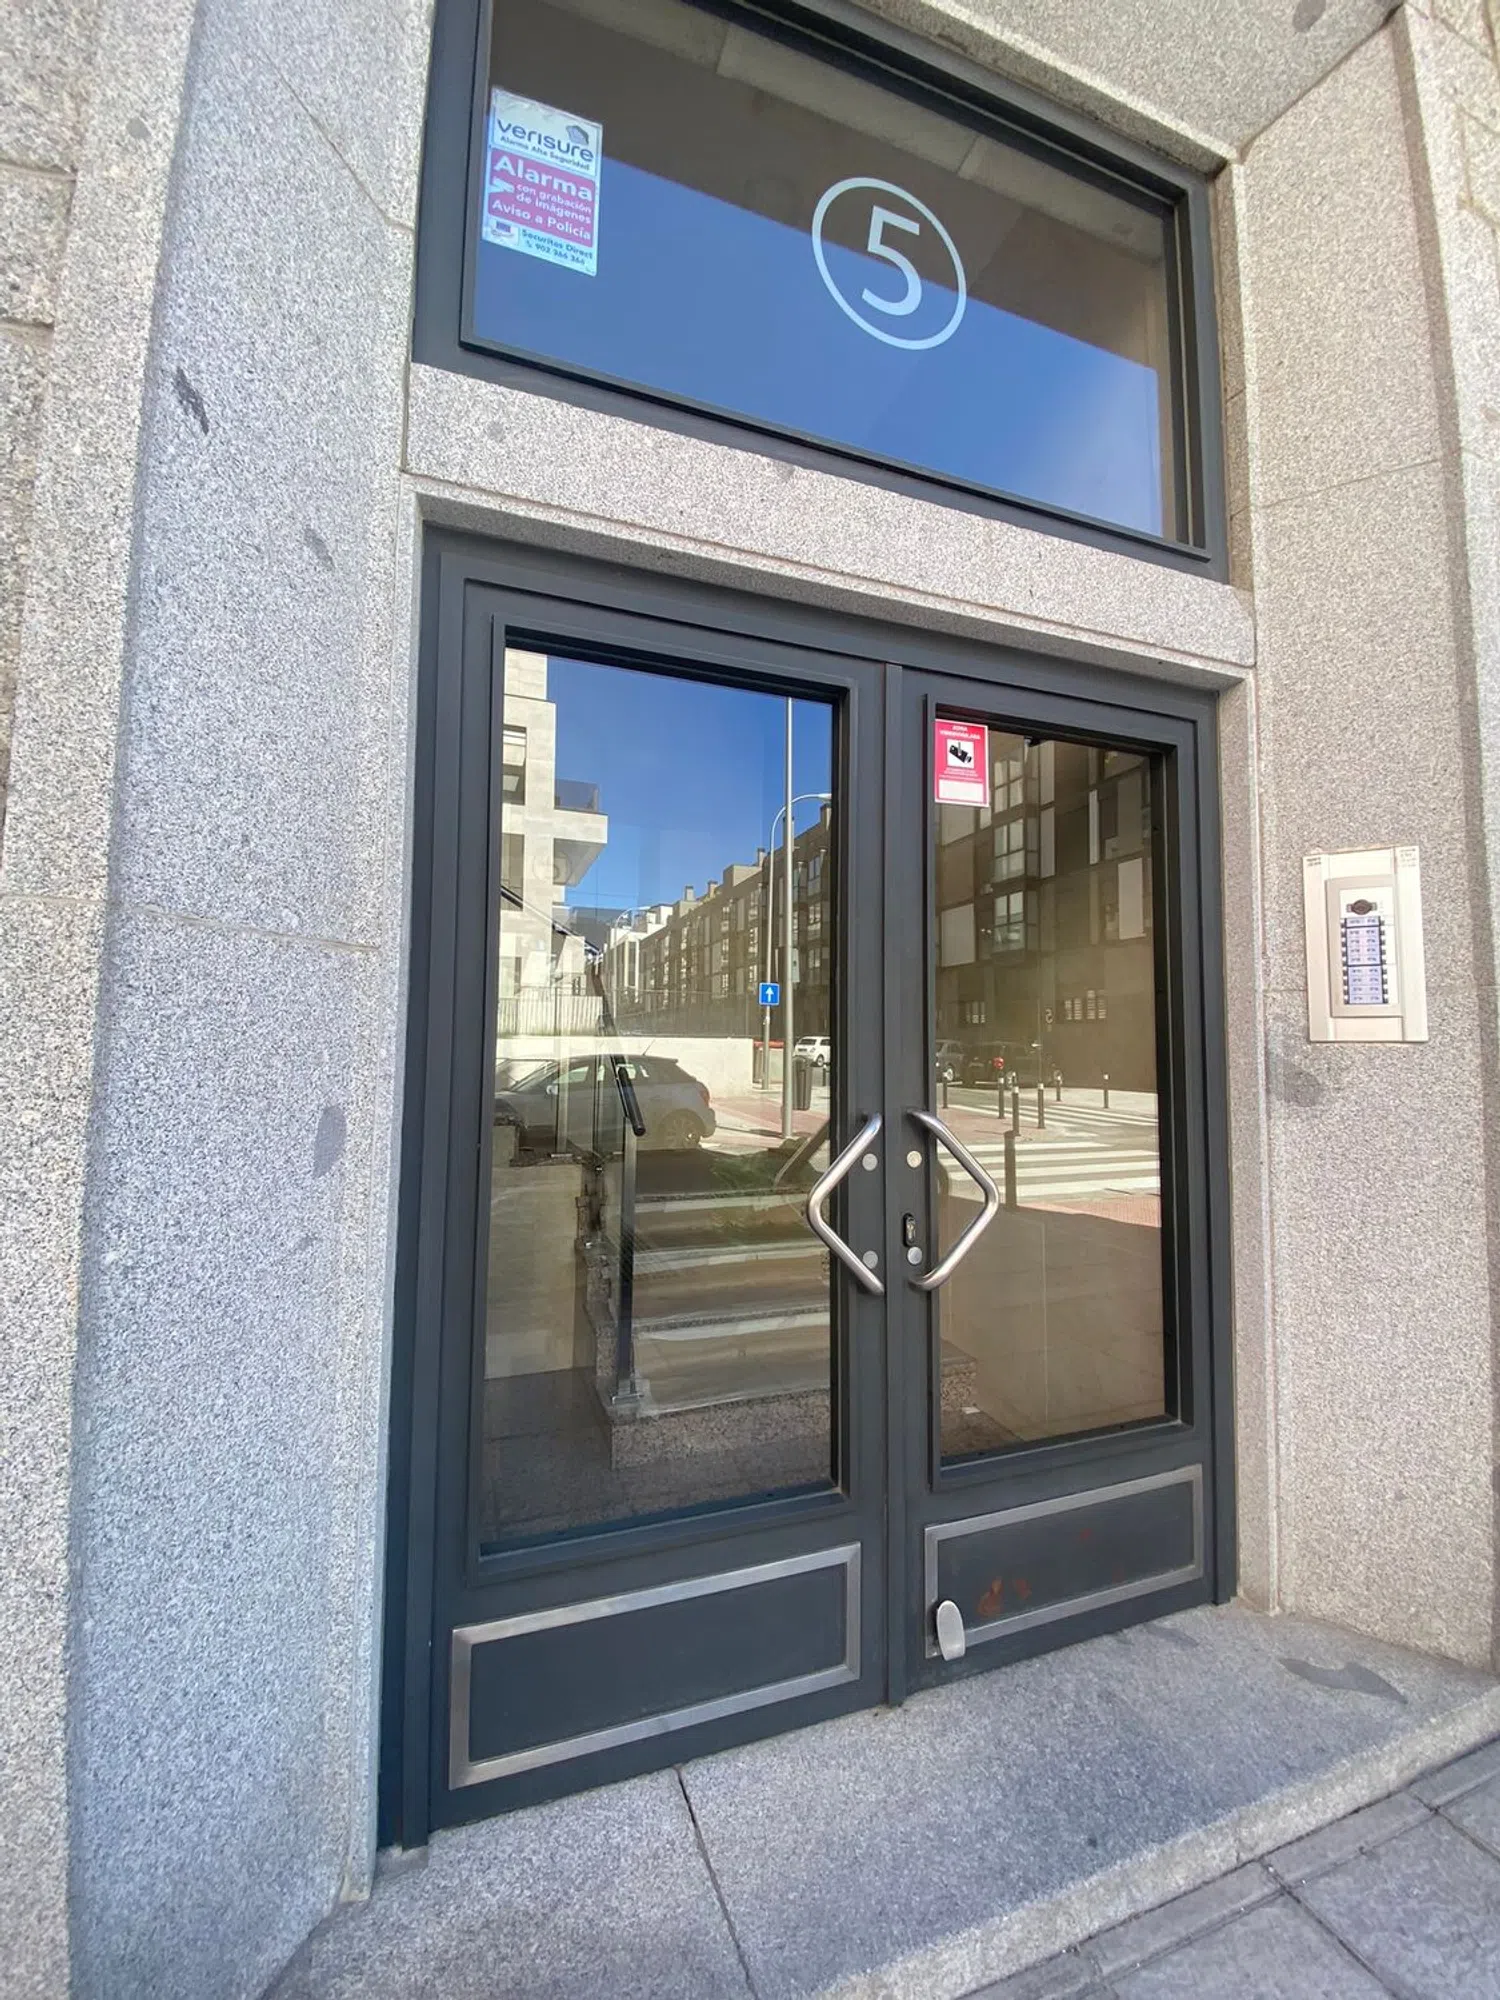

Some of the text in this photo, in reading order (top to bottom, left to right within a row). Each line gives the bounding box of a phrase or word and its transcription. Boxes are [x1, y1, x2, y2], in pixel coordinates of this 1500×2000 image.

[497, 119, 594, 162] verisure
[493, 155, 592, 202] Alarma
[549, 151, 590, 171] Seguridad
[516, 193, 532, 204] de
[516, 184, 592, 214] con grabación
[492, 200, 591, 240] Aviso a Policía
[522, 229, 563, 249] Securitas
[565, 244, 593, 259] Direct
[862, 205, 922, 316] 5
